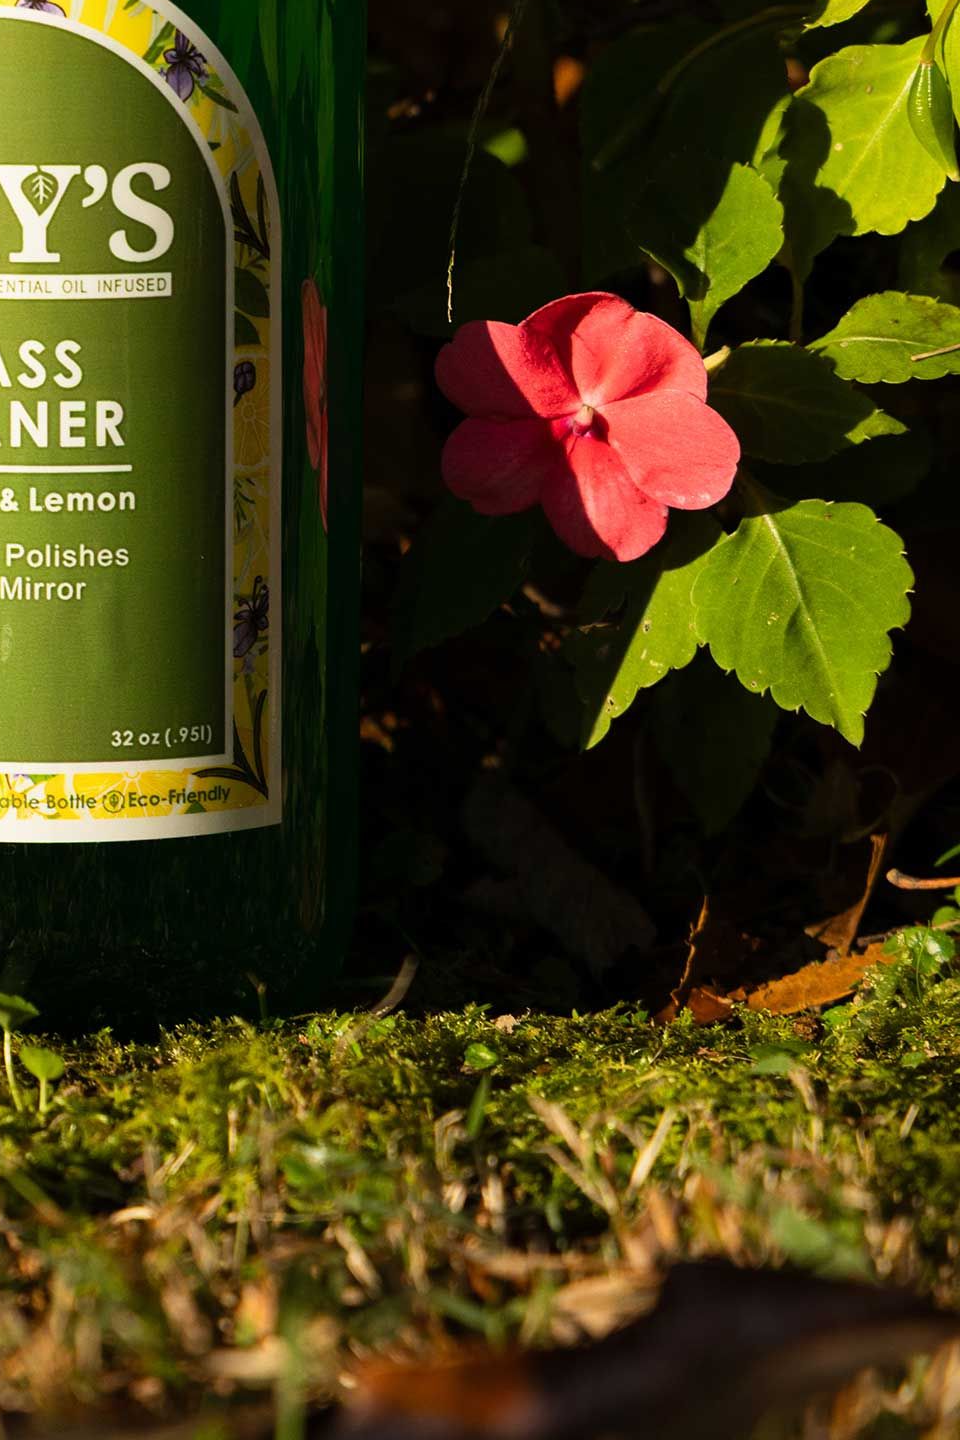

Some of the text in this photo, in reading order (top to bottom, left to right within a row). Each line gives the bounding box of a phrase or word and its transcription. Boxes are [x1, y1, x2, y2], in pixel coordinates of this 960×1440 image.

[61, 280, 87, 293] OIL
[97, 278, 167, 293] INFUSED
[0, 488, 19, 511] &
[29, 487, 135, 512] Lemon
[5, 544, 129, 568] Polishes
[0, 577, 86, 600] Mirror
[111, 730, 134, 747] 32
[139, 733, 160, 746] oz
[47, 794, 97, 809] Bottle
[129, 786, 231, 807] Eco-Friendly
